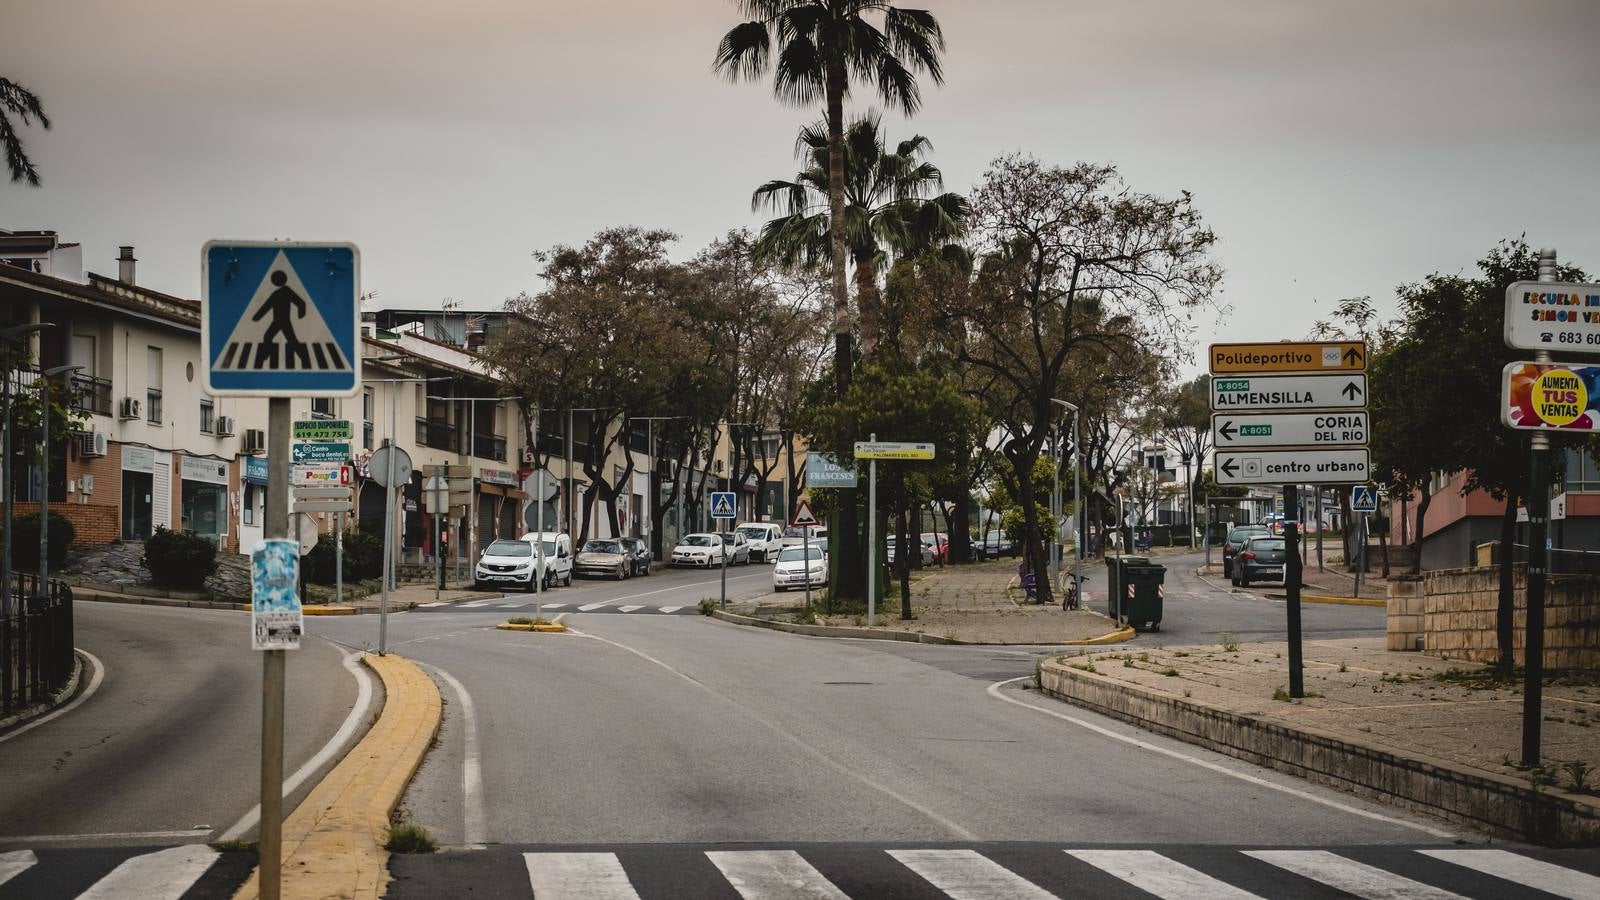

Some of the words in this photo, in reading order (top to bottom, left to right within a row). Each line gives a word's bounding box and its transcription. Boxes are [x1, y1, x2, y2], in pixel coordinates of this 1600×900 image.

[1523, 292, 1580, 306] ESCUELA
[1582, 311, 1600, 323] VE
[1559, 332, 1582, 344] 683
[1586, 333, 1600, 344] 60
[1216, 352, 1312, 366] Polideportivo
[1217, 382, 1249, 390] A-8054
[1542, 377, 1579, 390] AUMENTA
[1217, 391, 1314, 405] ALMENSILLA
[1543, 390, 1578, 404] TUS
[1541, 404, 1578, 417] VENTAS
[1314, 416, 1363, 429] CORIA
[1241, 426, 1271, 435] A-8051
[1314, 431, 1337, 441] DEL
[1342, 430, 1363, 441] RÍO
[1266, 462, 1311, 473] centro
[1316, 461, 1365, 472] urbano
[810, 472, 854, 480] FRANCESES
